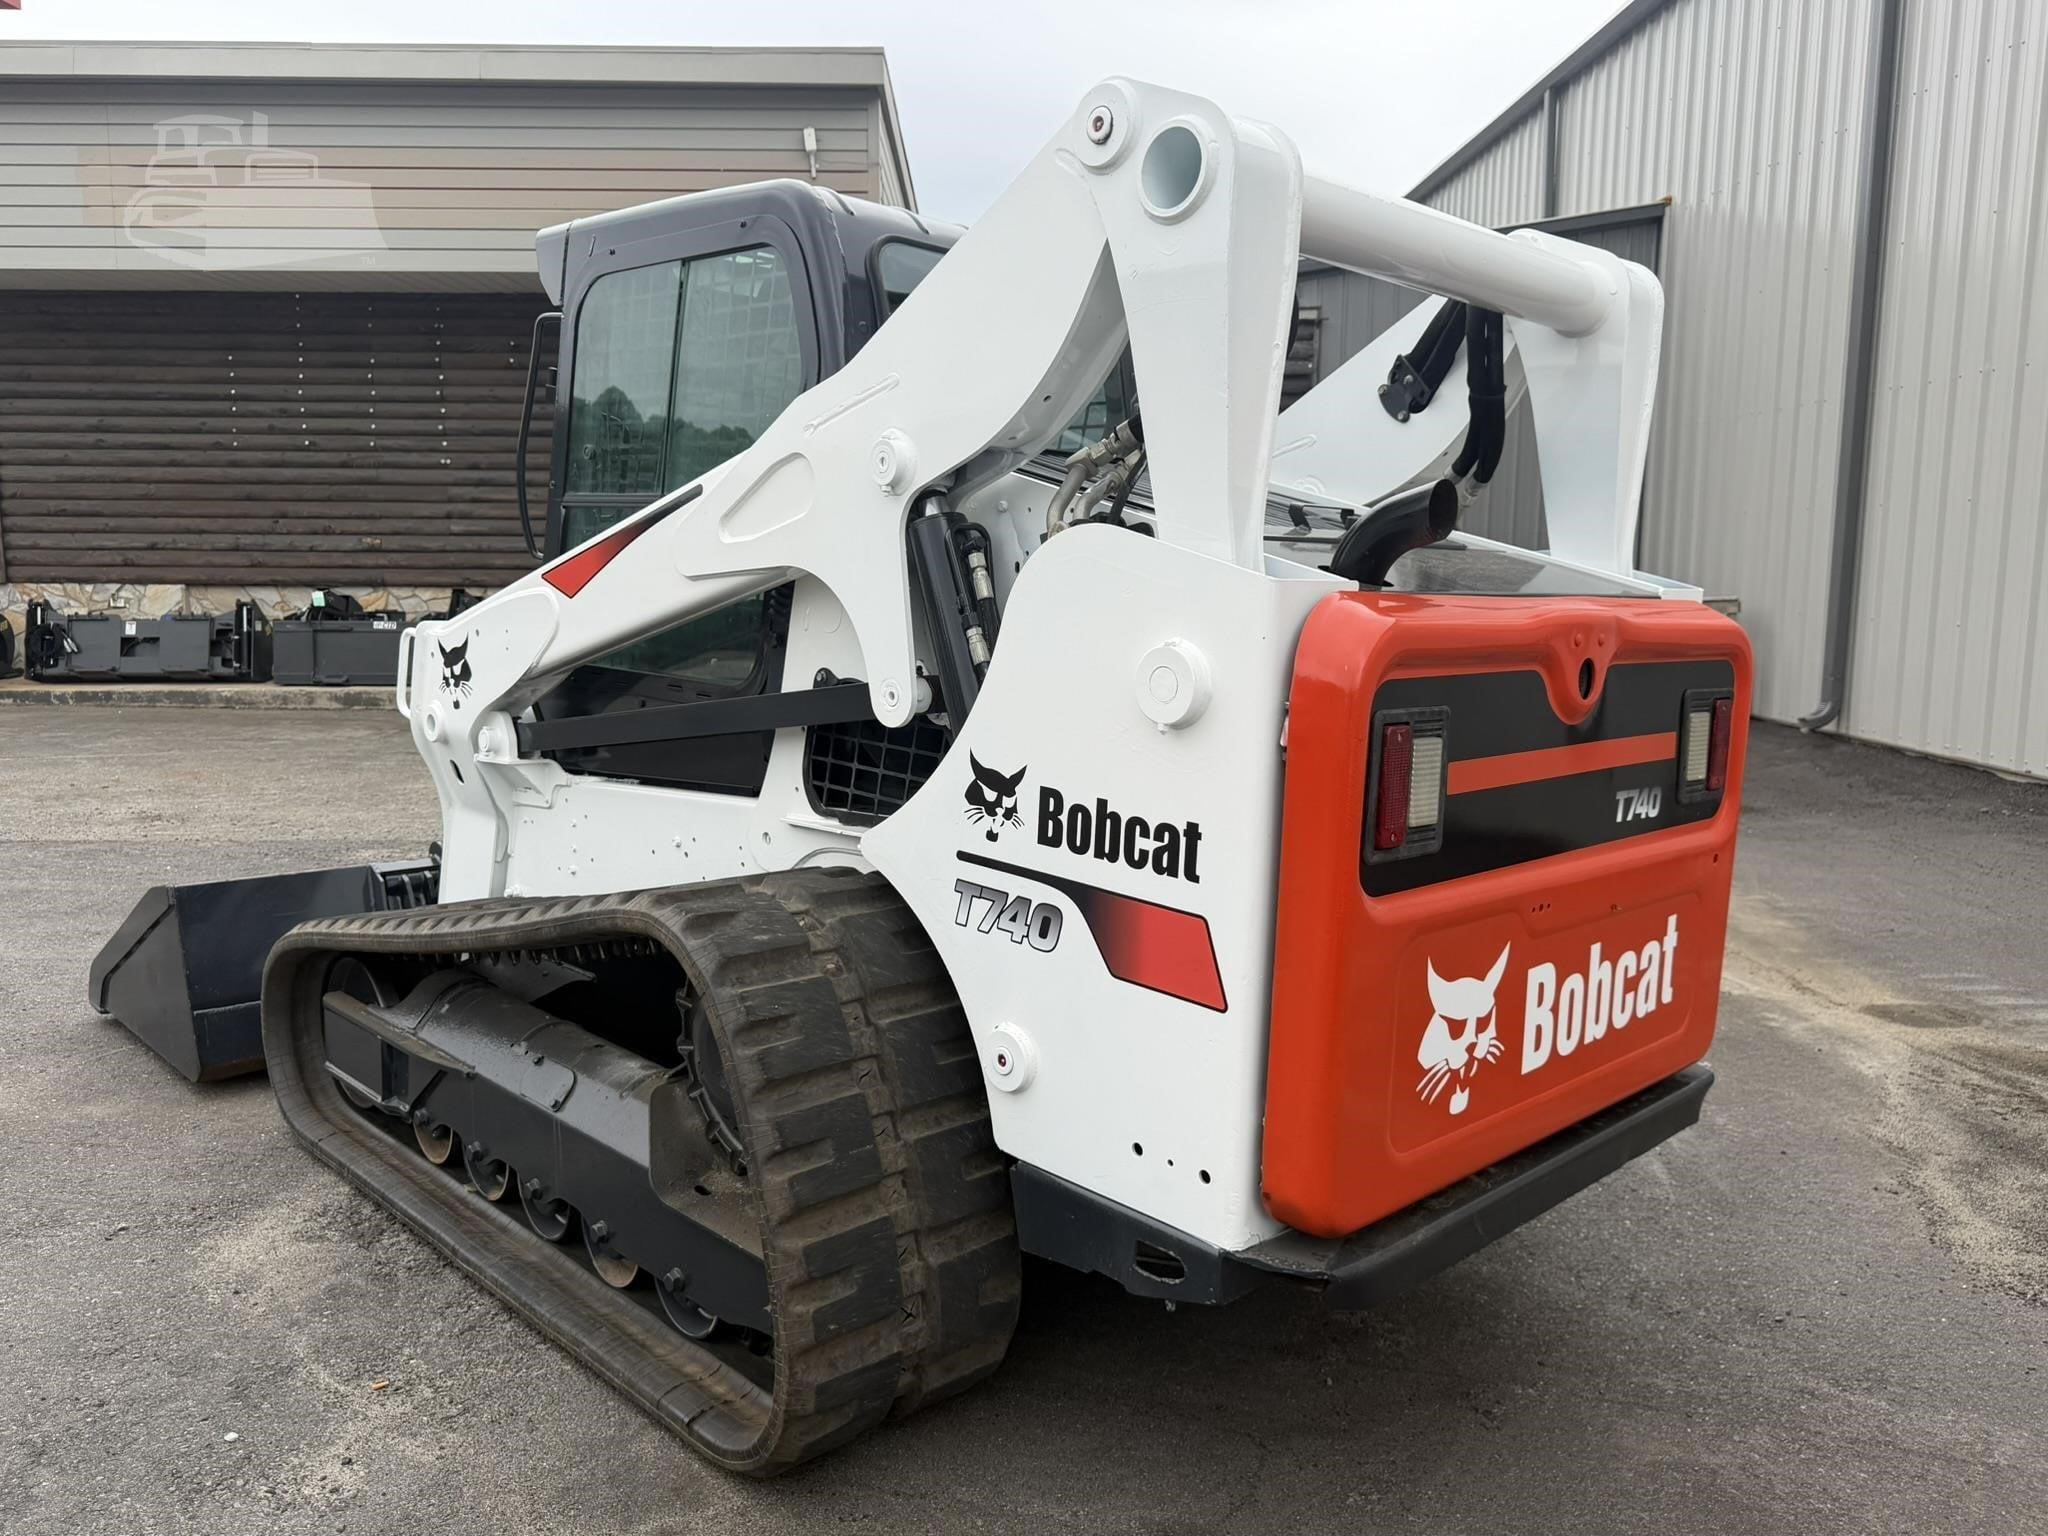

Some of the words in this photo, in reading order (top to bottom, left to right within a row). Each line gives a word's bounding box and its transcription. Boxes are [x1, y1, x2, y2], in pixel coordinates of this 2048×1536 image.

[1037, 785, 1202, 884] Bobcat
[1615, 787, 1661, 823] T740
[954, 878, 1064, 953] T740
[1521, 914, 1678, 1076] Bobcat
